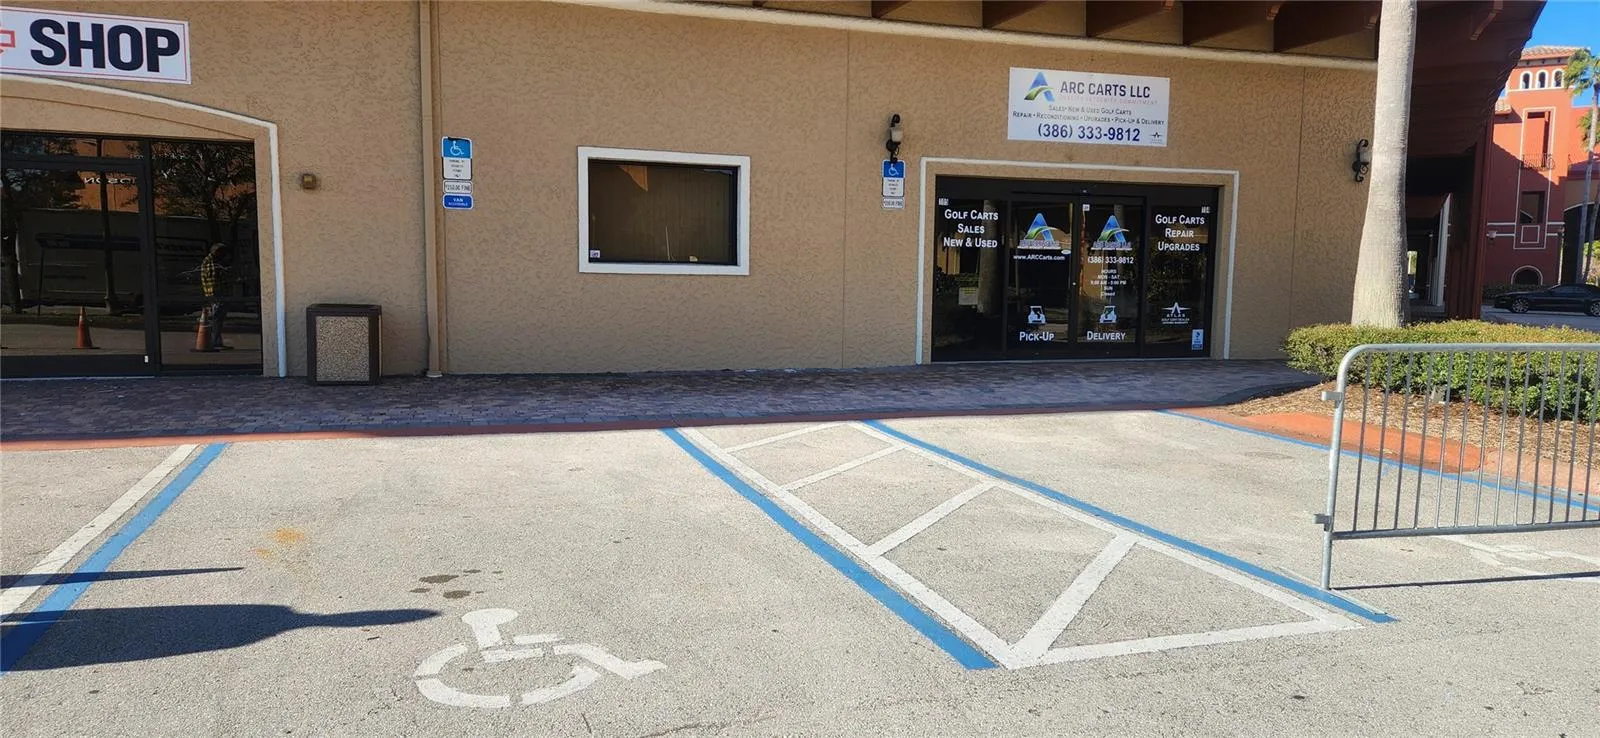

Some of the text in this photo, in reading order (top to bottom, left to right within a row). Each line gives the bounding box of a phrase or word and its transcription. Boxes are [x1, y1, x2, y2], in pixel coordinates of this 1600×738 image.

[30, 19, 180, 72] SHOP
[1060, 81, 1151, 98] ARC CARTS LLC
[1038, 123, 1141, 141] (386) 333-9812
[965, 237, 973, 247] &
[1088, 256, 1134, 264] (386) 333-9812
